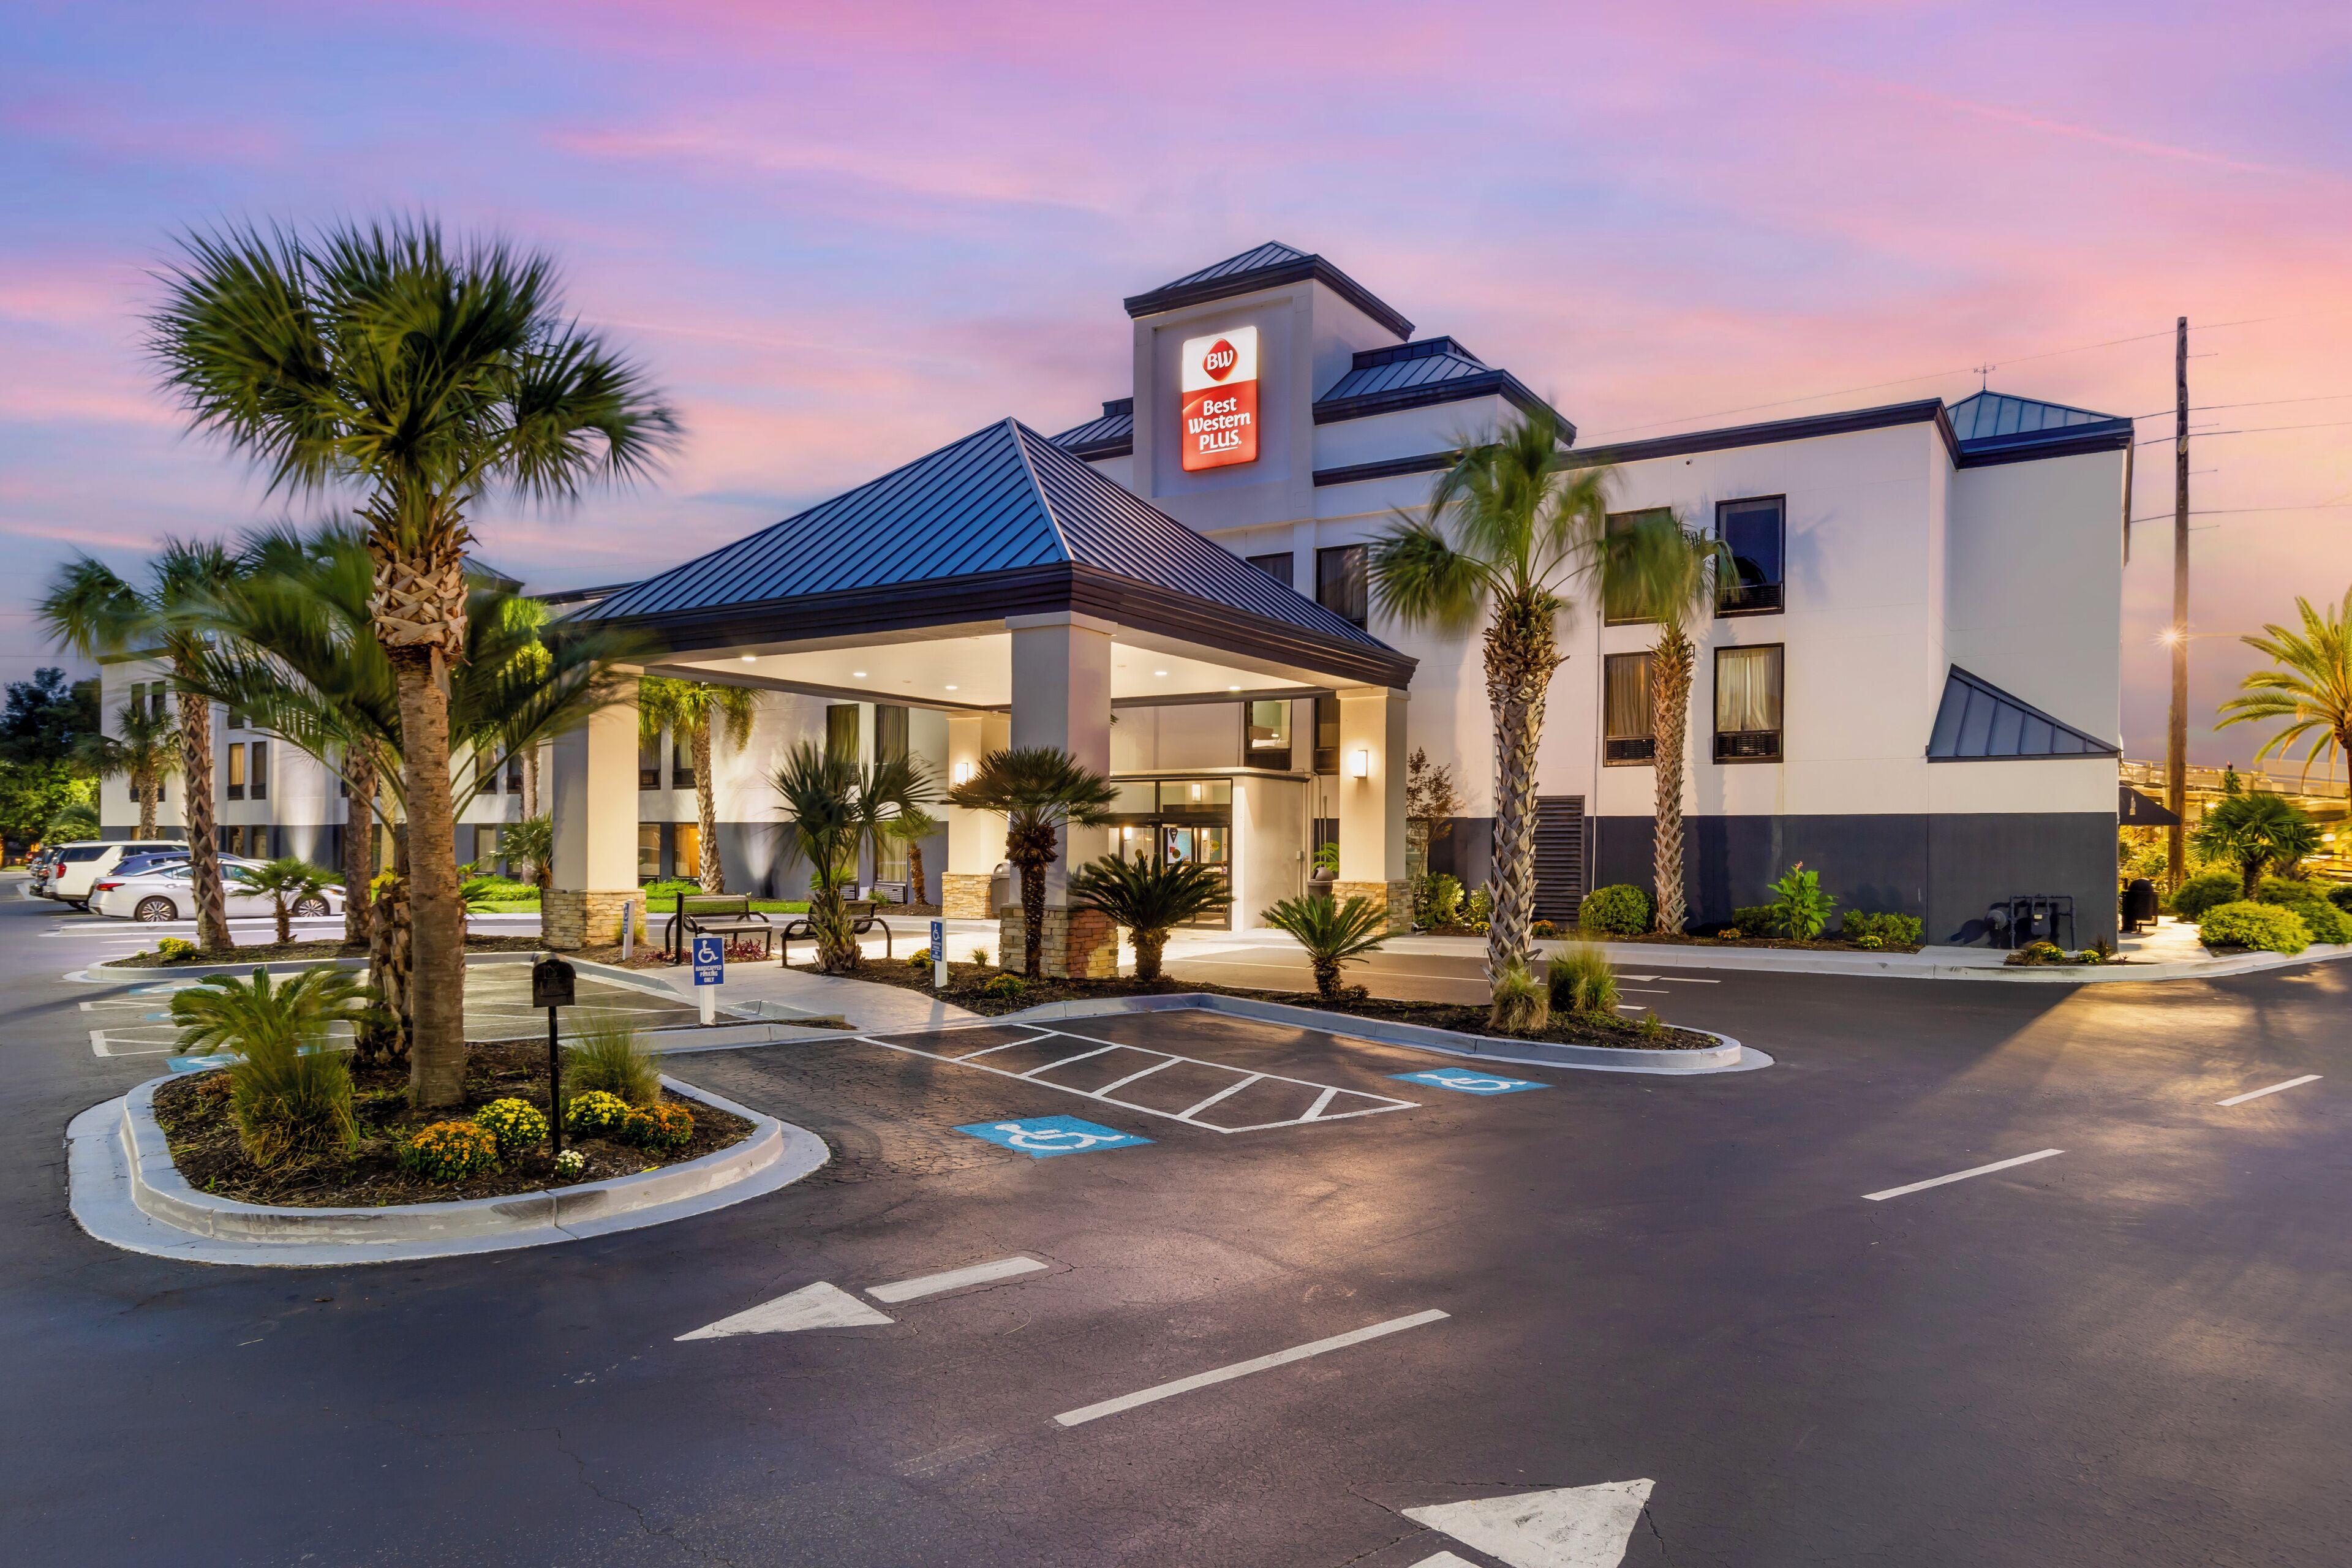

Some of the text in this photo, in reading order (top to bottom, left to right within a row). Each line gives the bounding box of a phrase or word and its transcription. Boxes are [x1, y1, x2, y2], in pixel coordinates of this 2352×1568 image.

[1207, 350, 1233, 370] BW
[1204, 397, 1237, 416] Best
[1188, 412, 1251, 434] Western
